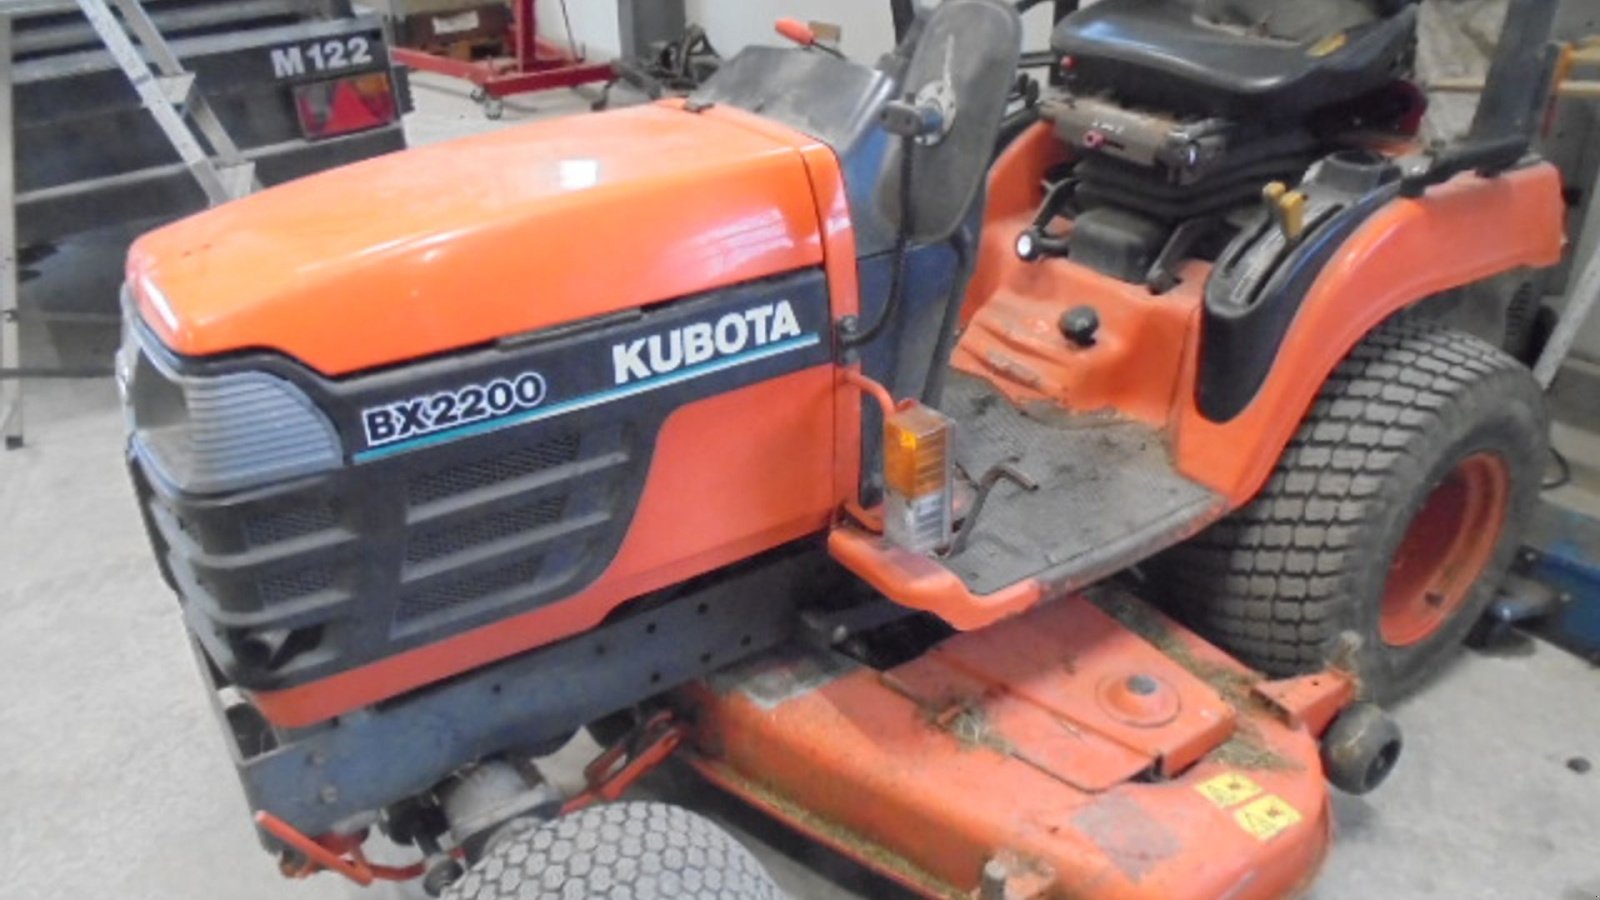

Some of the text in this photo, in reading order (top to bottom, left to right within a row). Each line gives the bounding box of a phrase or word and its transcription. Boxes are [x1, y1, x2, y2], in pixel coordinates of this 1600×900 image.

[271, 37, 373, 78] M 122
[612, 300, 802, 385] KUBOTA
[362, 372, 547, 447] BX2200
